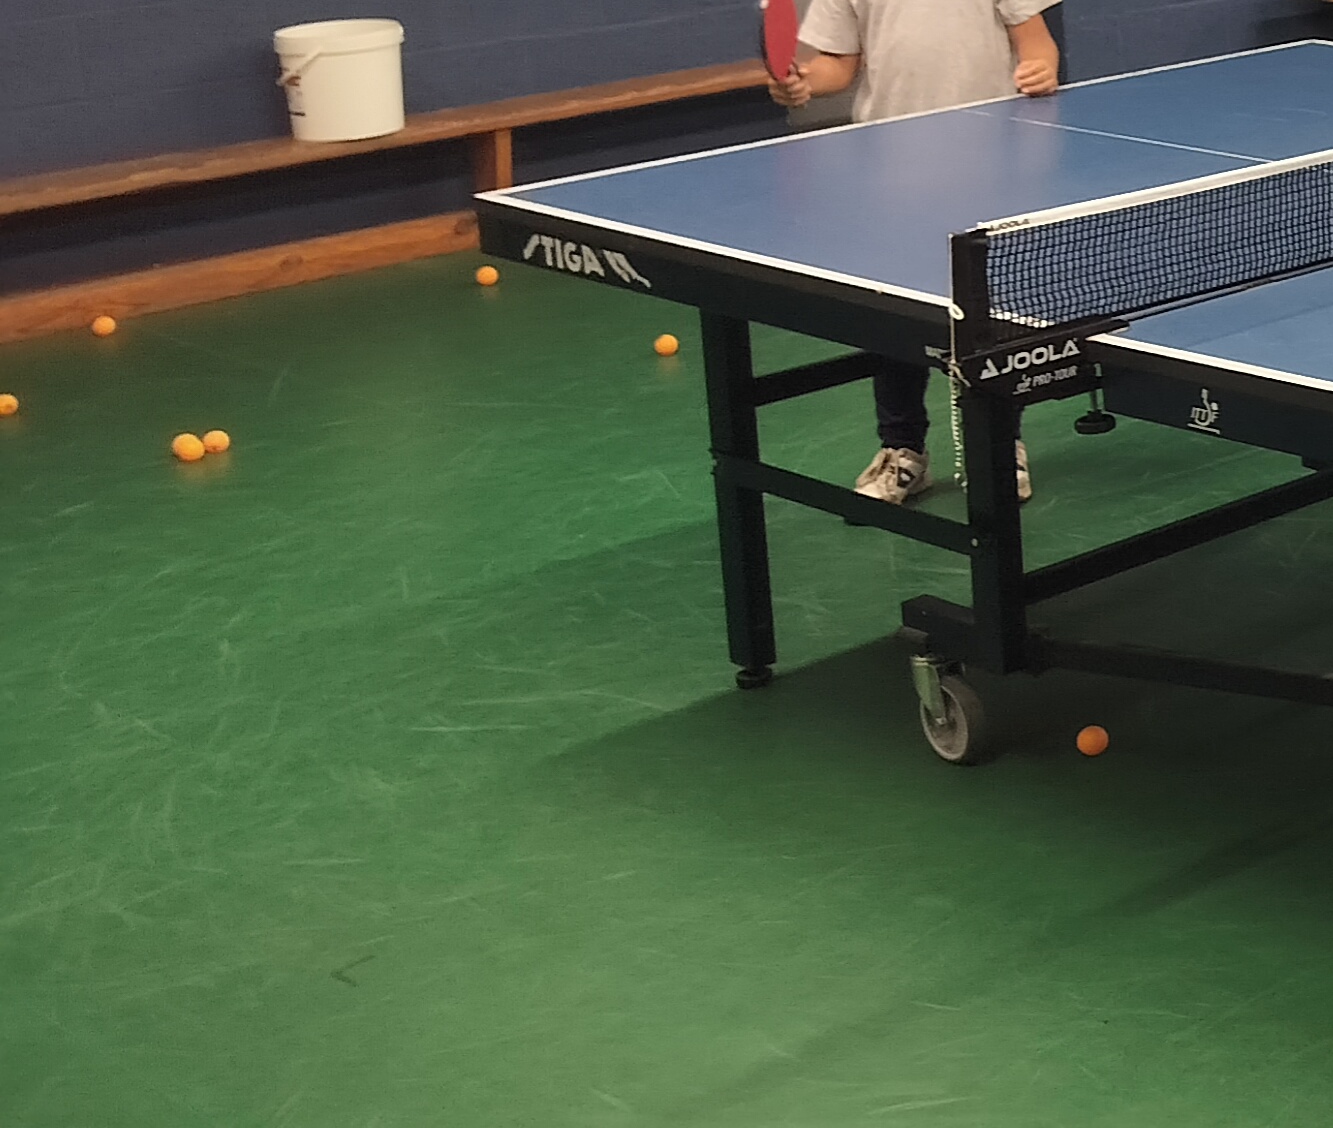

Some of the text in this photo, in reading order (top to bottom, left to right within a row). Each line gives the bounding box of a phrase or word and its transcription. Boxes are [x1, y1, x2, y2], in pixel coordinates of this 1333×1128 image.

[523, 233, 606, 278] STIGA
[1000, 340, 1081, 375] JOOLA
[1032, 365, 1078, 387] PRO-TOUR
